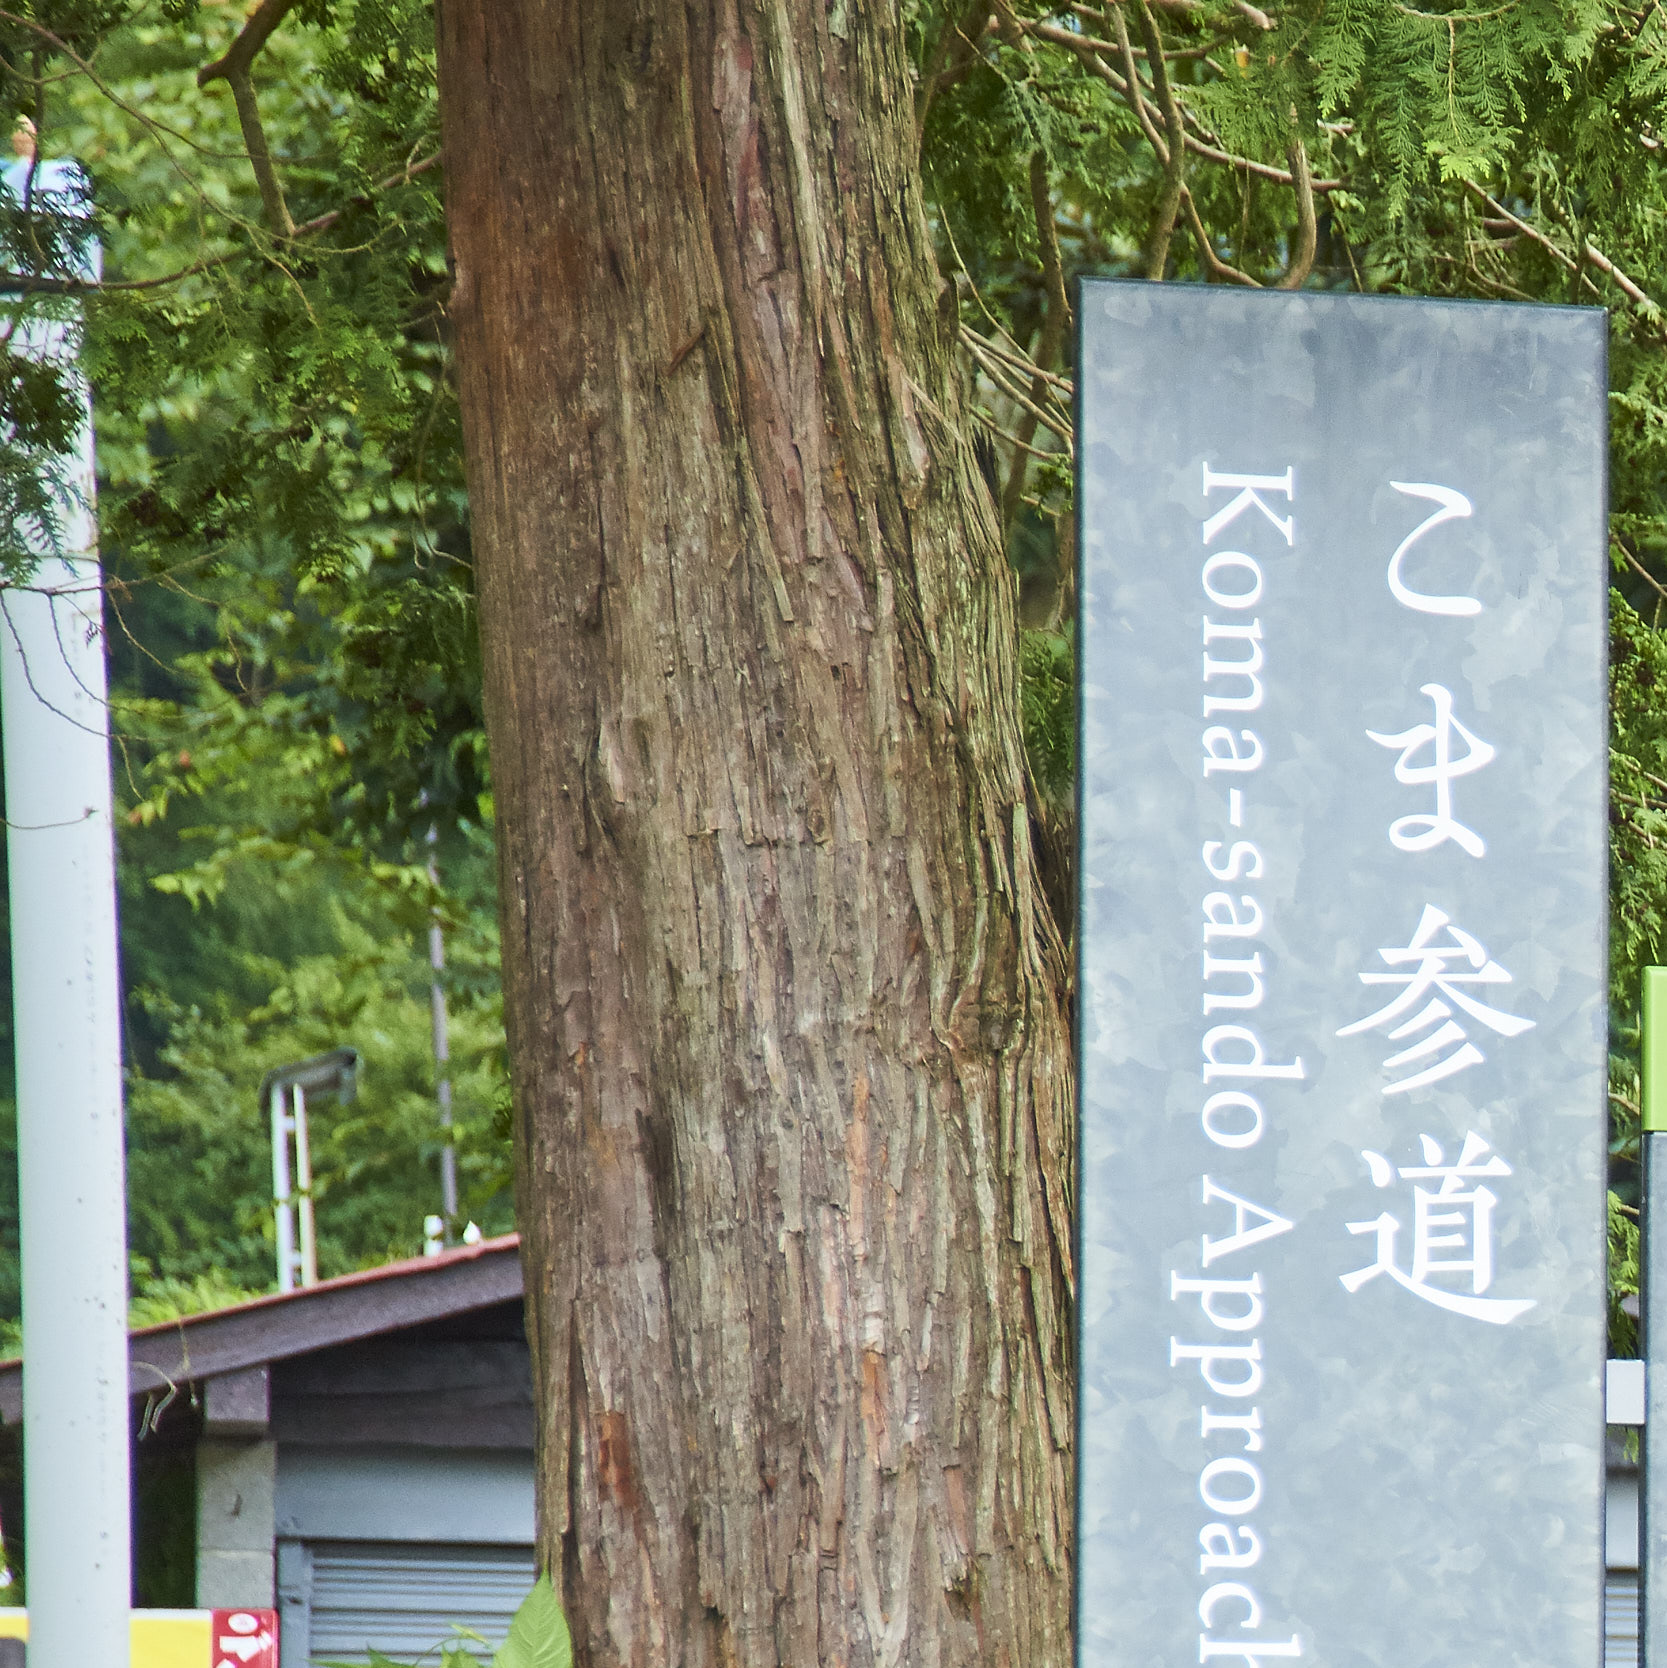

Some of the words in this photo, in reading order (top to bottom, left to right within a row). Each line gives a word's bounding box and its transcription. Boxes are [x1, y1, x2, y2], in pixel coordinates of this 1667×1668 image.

[1200, 460, 1305, 1150] Koma-sando
[1335, 479, 1538, 1326] こま参道
